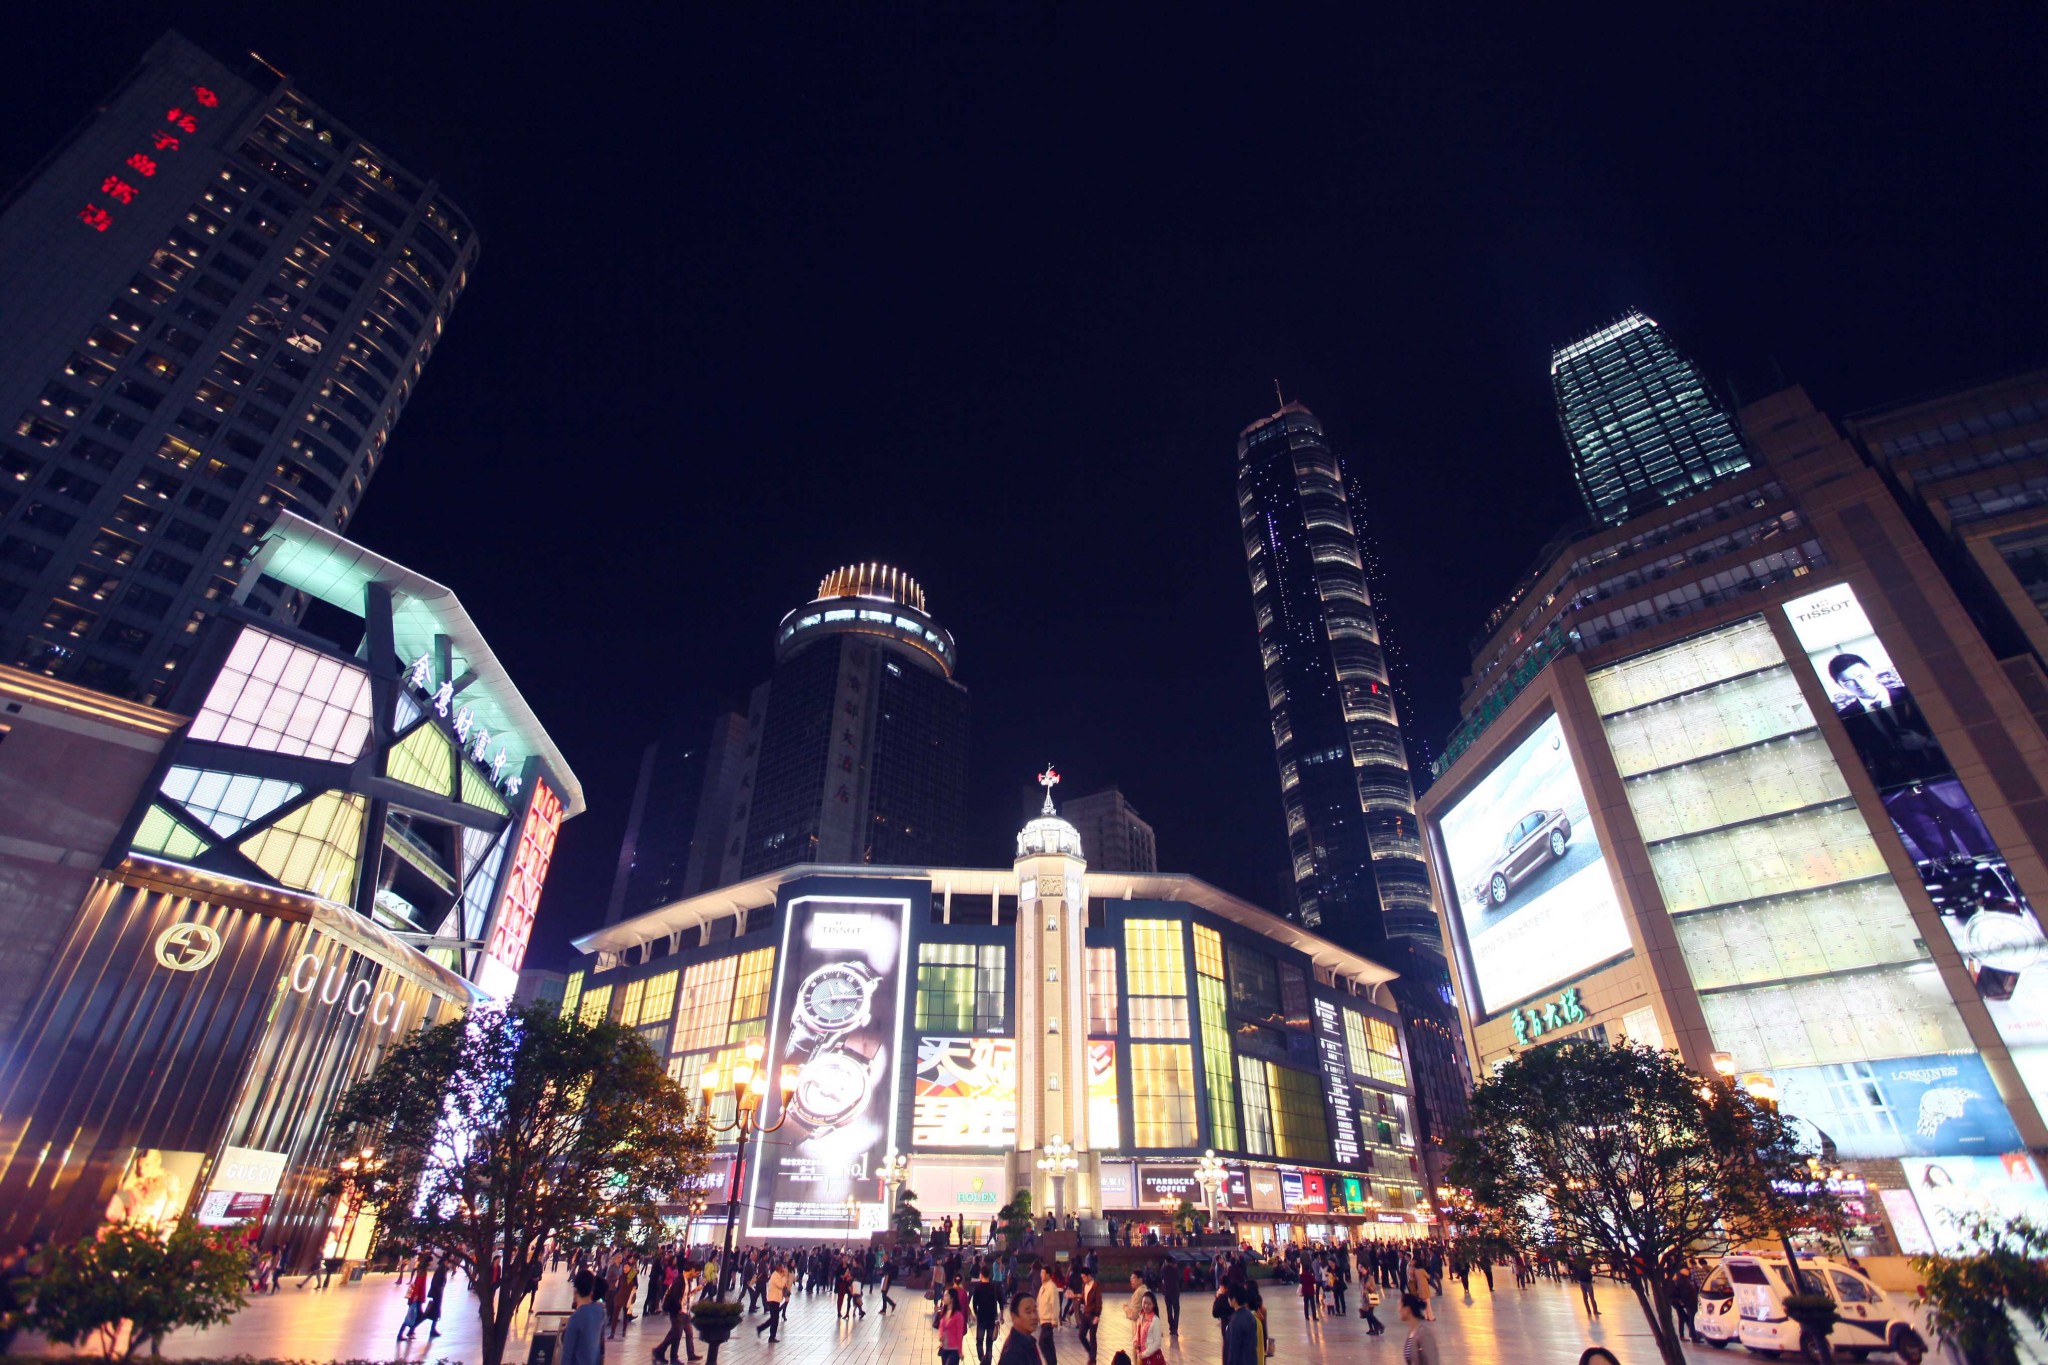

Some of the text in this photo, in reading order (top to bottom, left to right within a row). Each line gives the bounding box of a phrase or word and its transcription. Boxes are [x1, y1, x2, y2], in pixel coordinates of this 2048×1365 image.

[1796, 599, 1851, 622] TISSOT
[411, 652, 523, 796] 金鹰财富中心
[822, 925, 863, 935] TISSOT
[293, 953, 406, 1033] GUCCI
[1511, 987, 1585, 1046] 重百大楼
[1890, 1066, 1959, 1081] LONGINES
[226, 1163, 276, 1182] GUCCI
[1146, 1177, 1195, 1185] STARBUCKS
[956, 1191, 997, 1203] ROLEX
[1155, 1185, 1187, 1193] COFFEE
